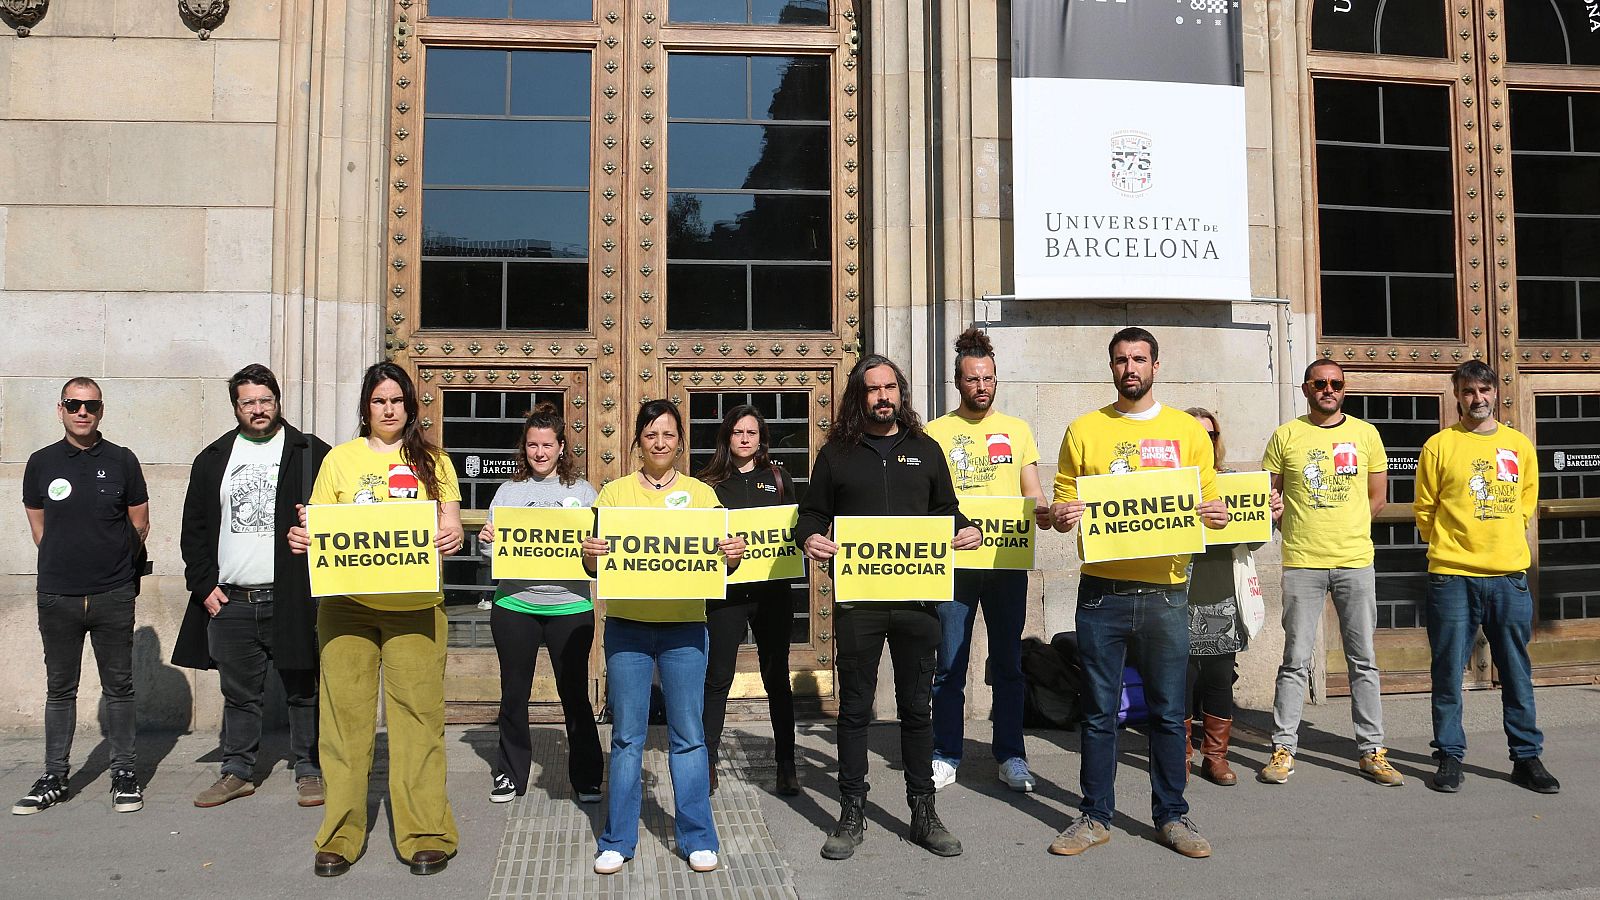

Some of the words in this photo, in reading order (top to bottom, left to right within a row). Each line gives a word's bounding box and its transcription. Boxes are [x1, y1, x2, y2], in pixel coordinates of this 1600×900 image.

[1203, 224, 1219, 232] DE
[1045, 237, 1220, 260] BARCELONA
[991, 455, 1012, 464] CGT
[1336, 465, 1357, 475] CGT
[1085, 494, 1195, 519] TORNEU
[1088, 523, 1101, 536] A
[1105, 515, 1196, 534] NEGOCIAR
[314, 529, 430, 551] TORNEU
[498, 528, 591, 544] TORNEU
[498, 546, 509, 557] A
[605, 535, 720, 555] TORNEU
[841, 542, 947, 560] TORNEU
[316, 555, 329, 568] A
[334, 552, 430, 567] NEGOCIAR
[604, 558, 618, 571] A
[623, 558, 718, 572] NEGOCIAR
[841, 563, 853, 575] A
[858, 563, 946, 575] NEGOCIAR
